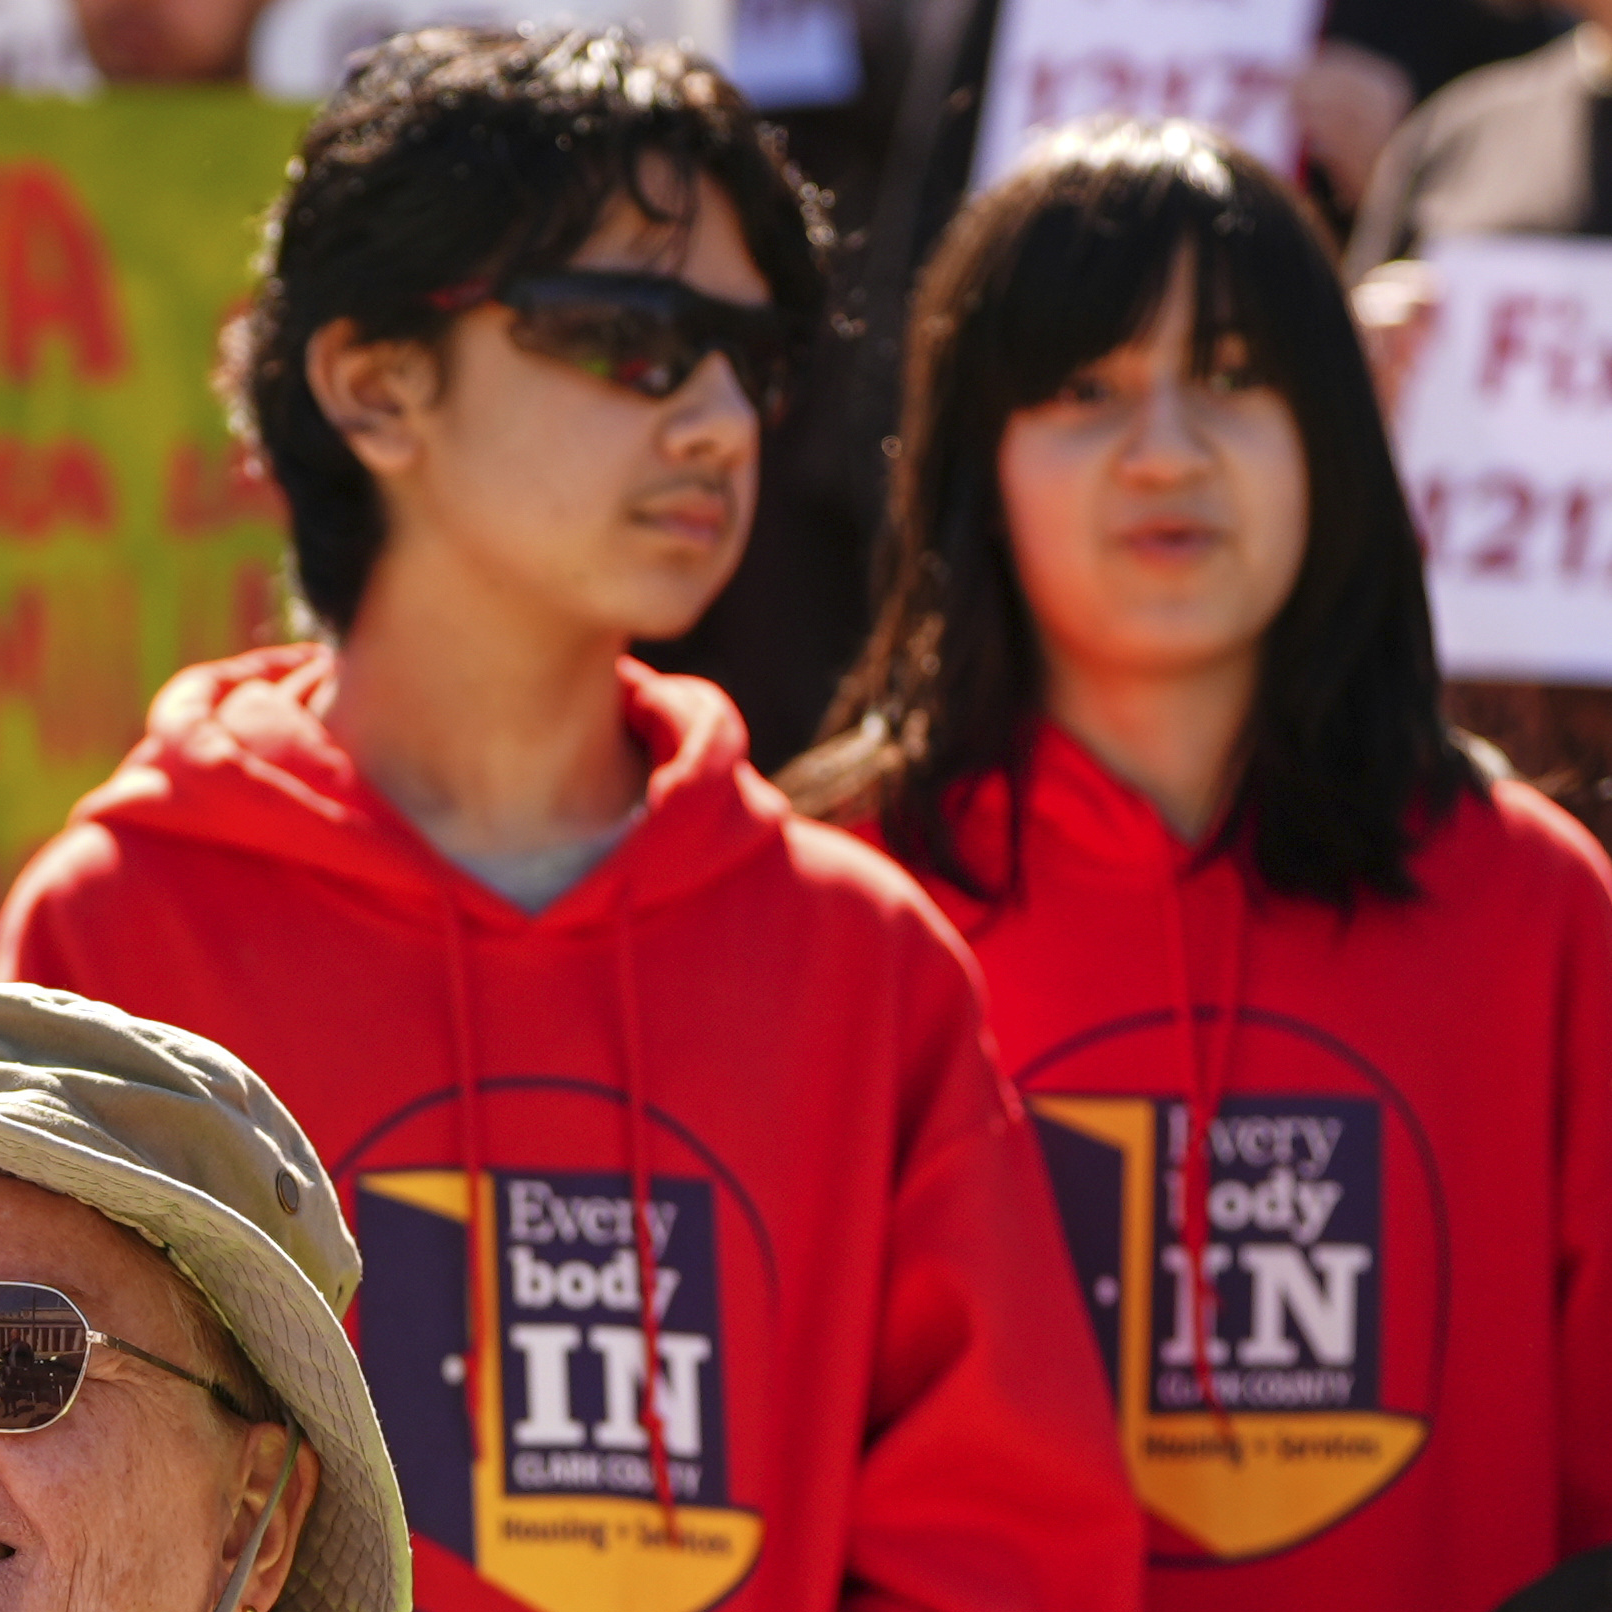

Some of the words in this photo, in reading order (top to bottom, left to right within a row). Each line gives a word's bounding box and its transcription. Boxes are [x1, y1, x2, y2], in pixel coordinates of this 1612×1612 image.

[1420, 475, 1612, 575] 121
[507, 1180, 679, 1262] Every
[508, 1246, 681, 1328] body
[1158, 1242, 1373, 1368] IN
[509, 1324, 712, 1458] IN
